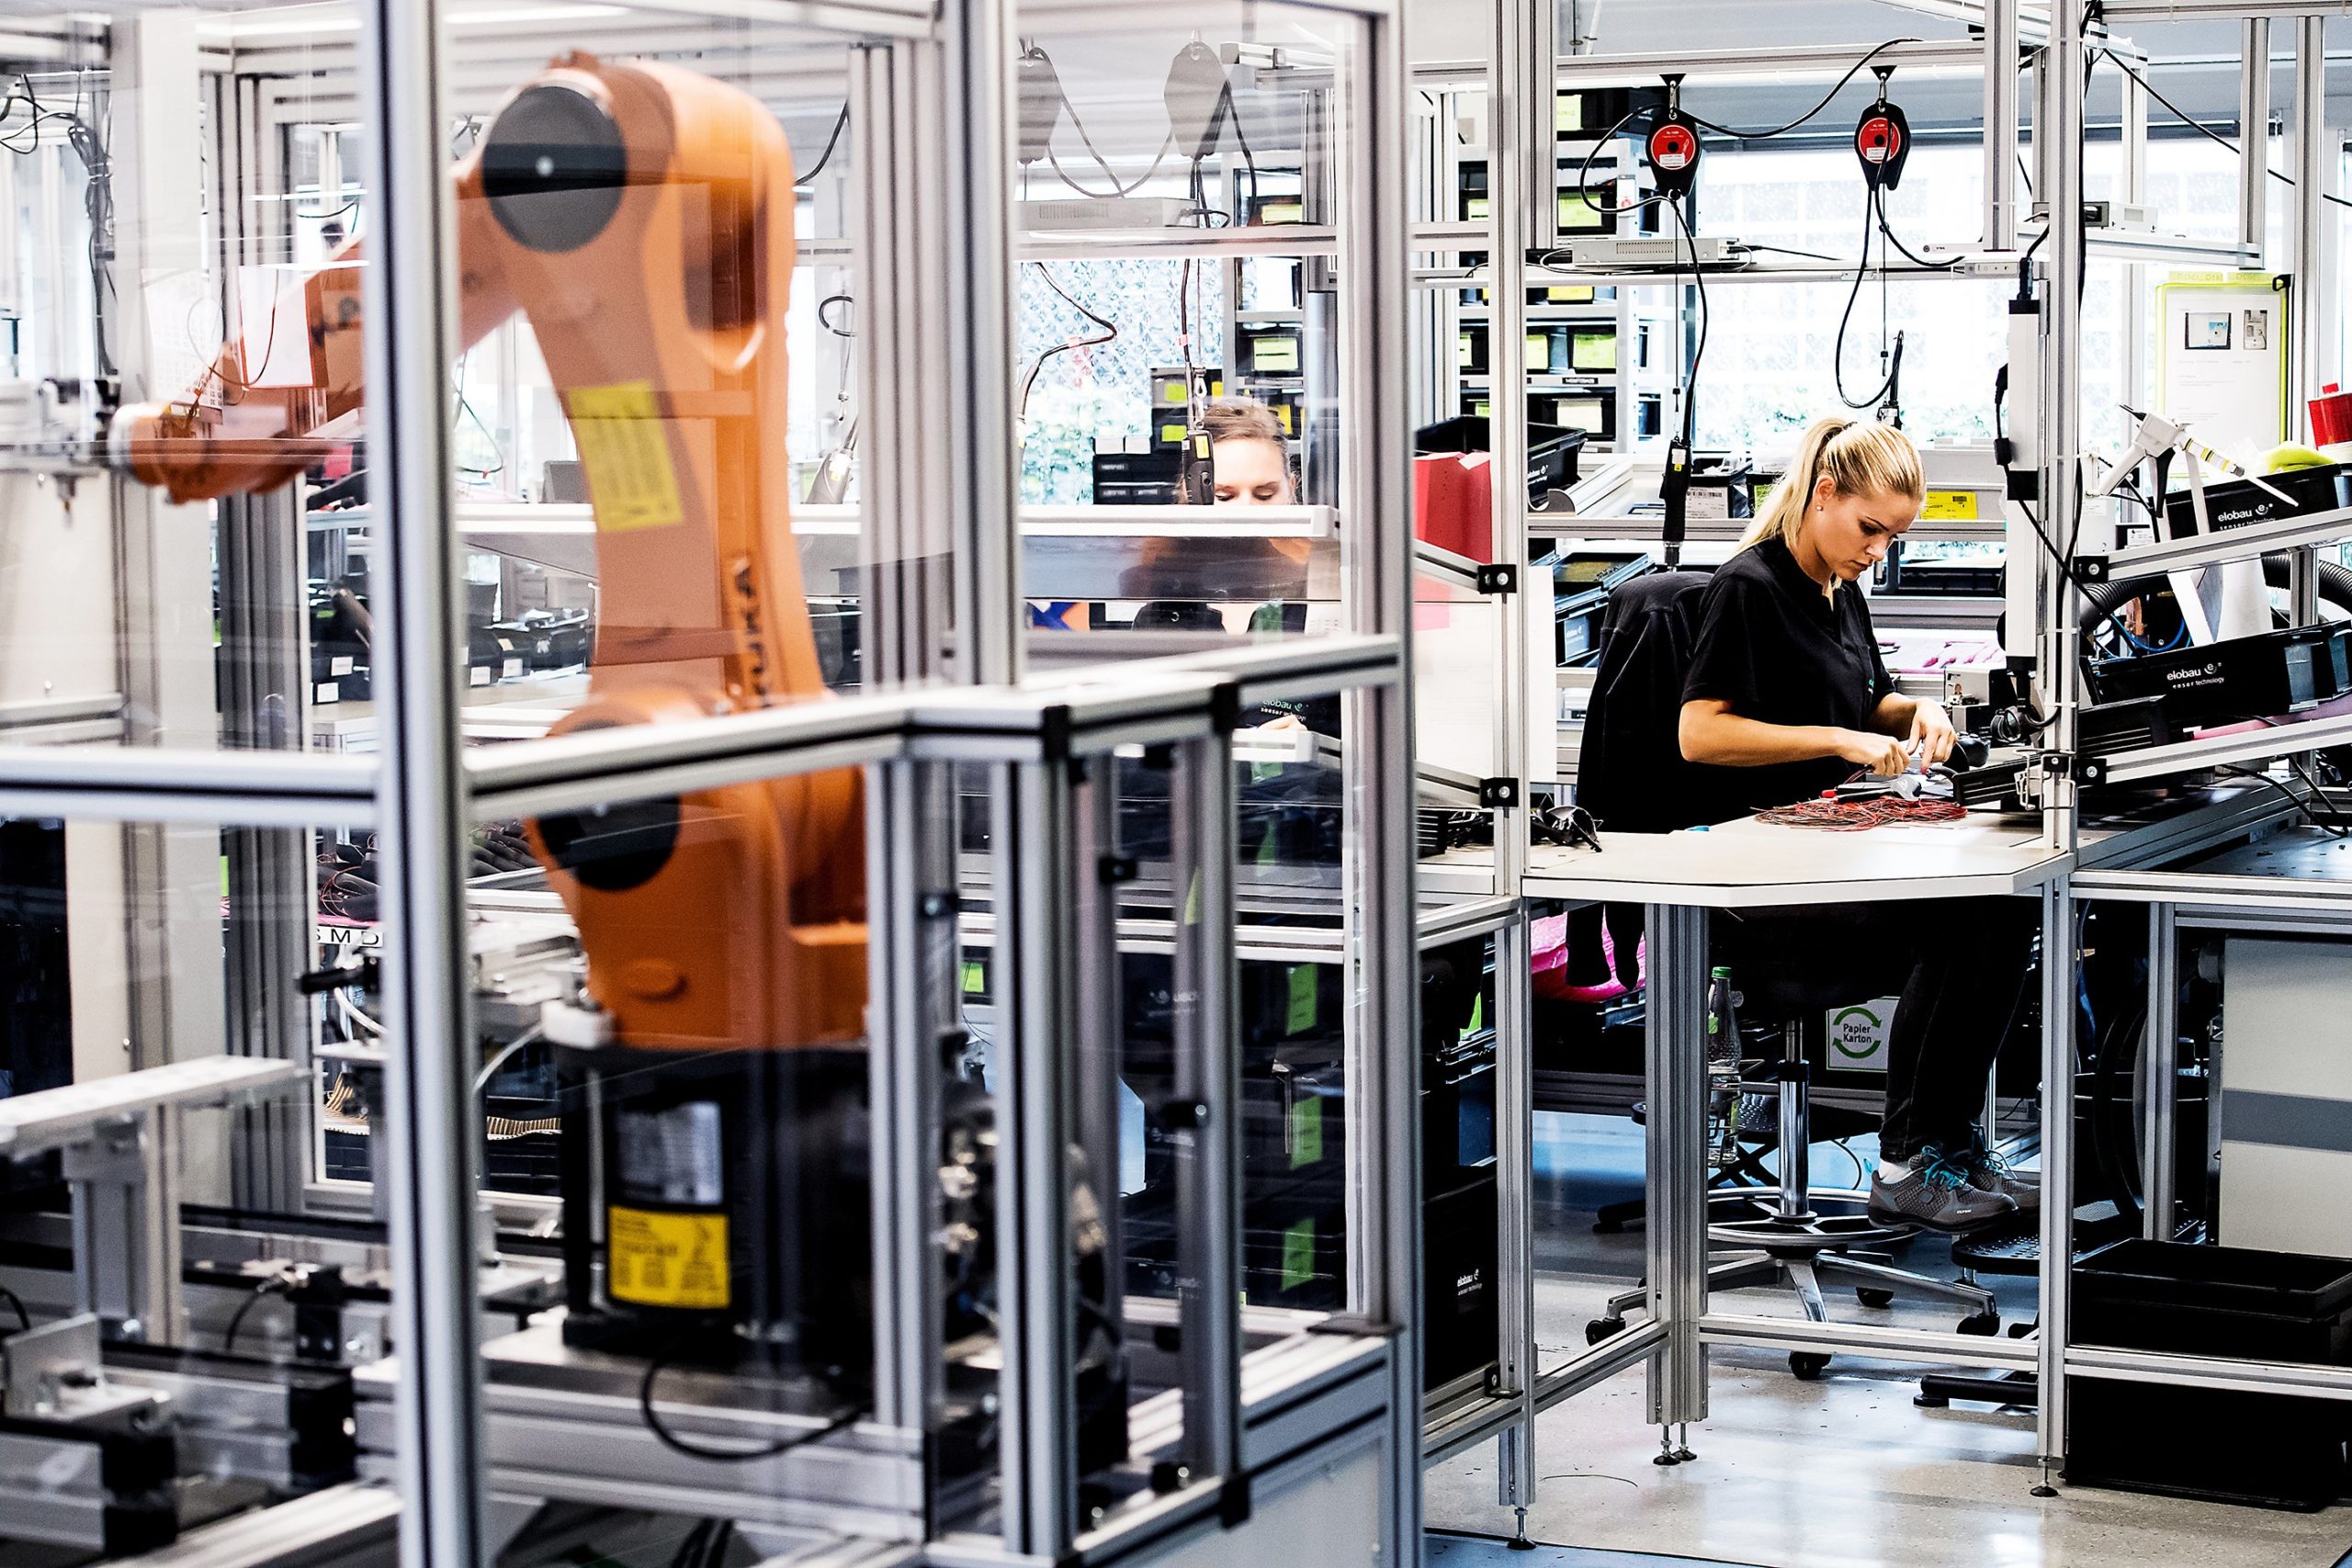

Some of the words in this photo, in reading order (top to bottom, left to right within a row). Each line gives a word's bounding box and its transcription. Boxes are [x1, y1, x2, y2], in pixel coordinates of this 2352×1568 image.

[2218, 510, 2253, 522] elobau
[2166, 669, 2201, 681] elobau
[1843, 1023, 1871, 1034] Papier
[1843, 1033, 1871, 1043] Karton
